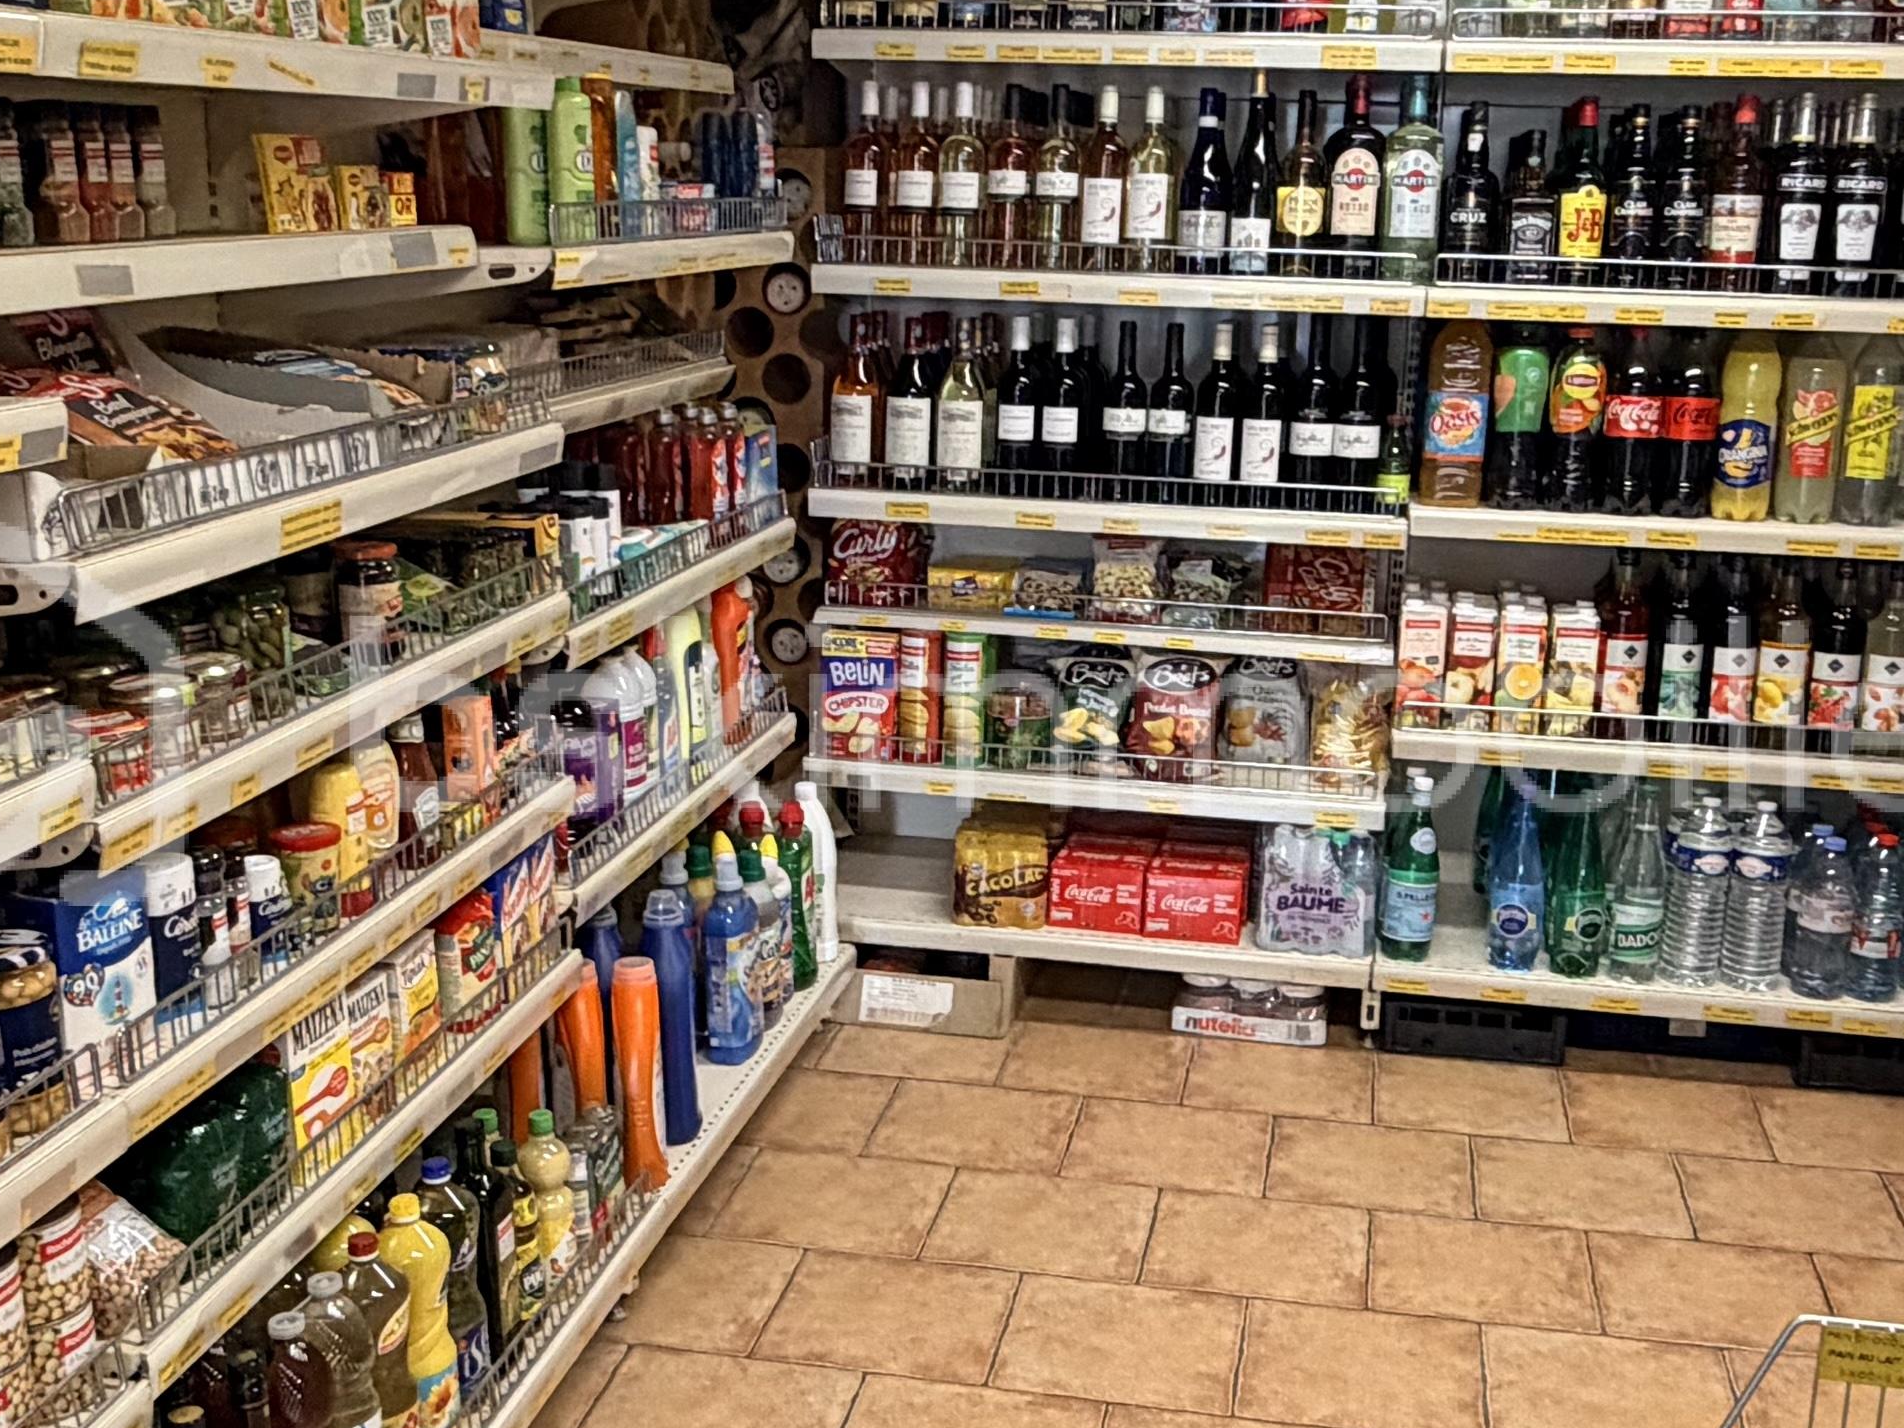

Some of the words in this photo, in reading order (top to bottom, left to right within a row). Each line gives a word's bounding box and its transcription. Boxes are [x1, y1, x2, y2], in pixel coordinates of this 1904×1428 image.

[1780, 175, 1828, 191] RICARD
[1836, 175, 1886, 191] RICARD
[1449, 211, 1488, 225] CRUZ
[832, 517, 899, 562] Curly
[829, 658, 889, 689] BELIN
[1276, 893, 1346, 915] BAUME
[75, 907, 144, 954] BALEINE
